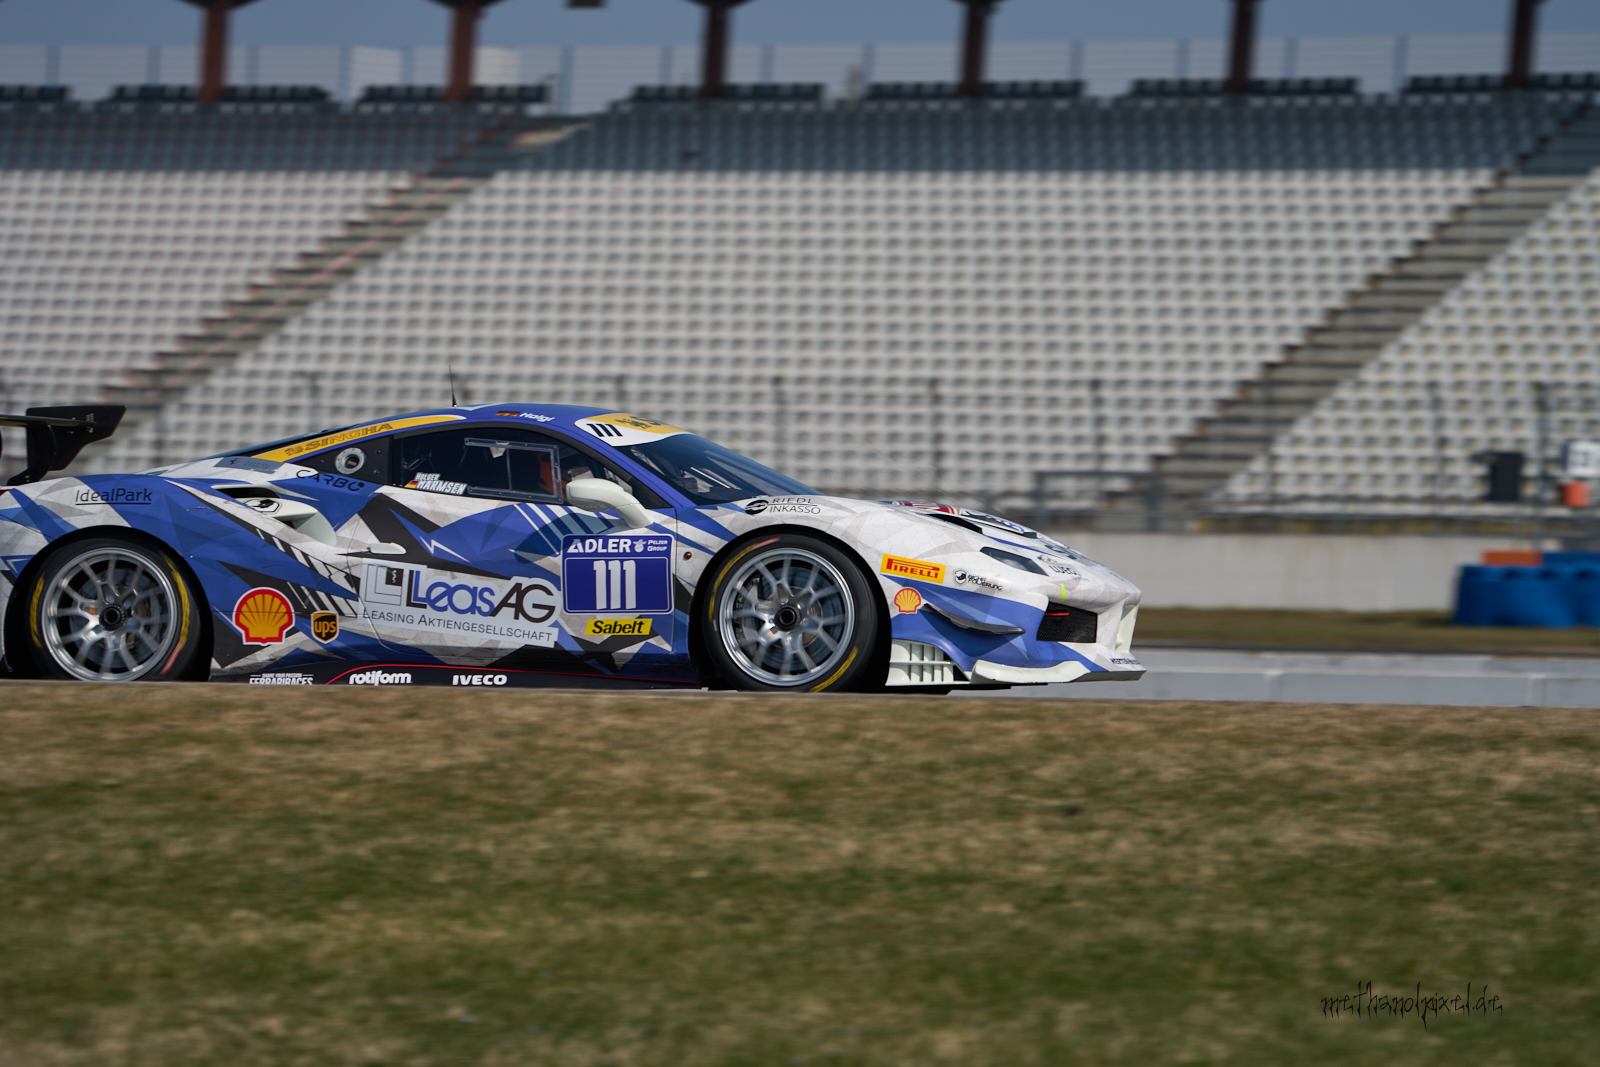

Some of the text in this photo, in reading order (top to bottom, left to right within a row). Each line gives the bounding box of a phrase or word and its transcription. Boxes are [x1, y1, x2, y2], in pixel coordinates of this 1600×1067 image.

[304, 423, 393, 450] SINGHA
[587, 423, 623, 437] 111
[75, 488, 153, 502] IdealPark
[416, 480, 468, 495] HARMSEN
[769, 505, 821, 515] INKASSO
[566, 538, 632, 553] ADLER
[885, 557, 941, 579] PIRELLI
[593, 560, 637, 610] 111
[314, 621, 337, 638] ups
[417, 614, 553, 642] AKTIENGESELLSCHAFT
[591, 620, 645, 634] Sabelt
[348, 670, 412, 687] rotiform
[452, 674, 508, 686] IVECO
